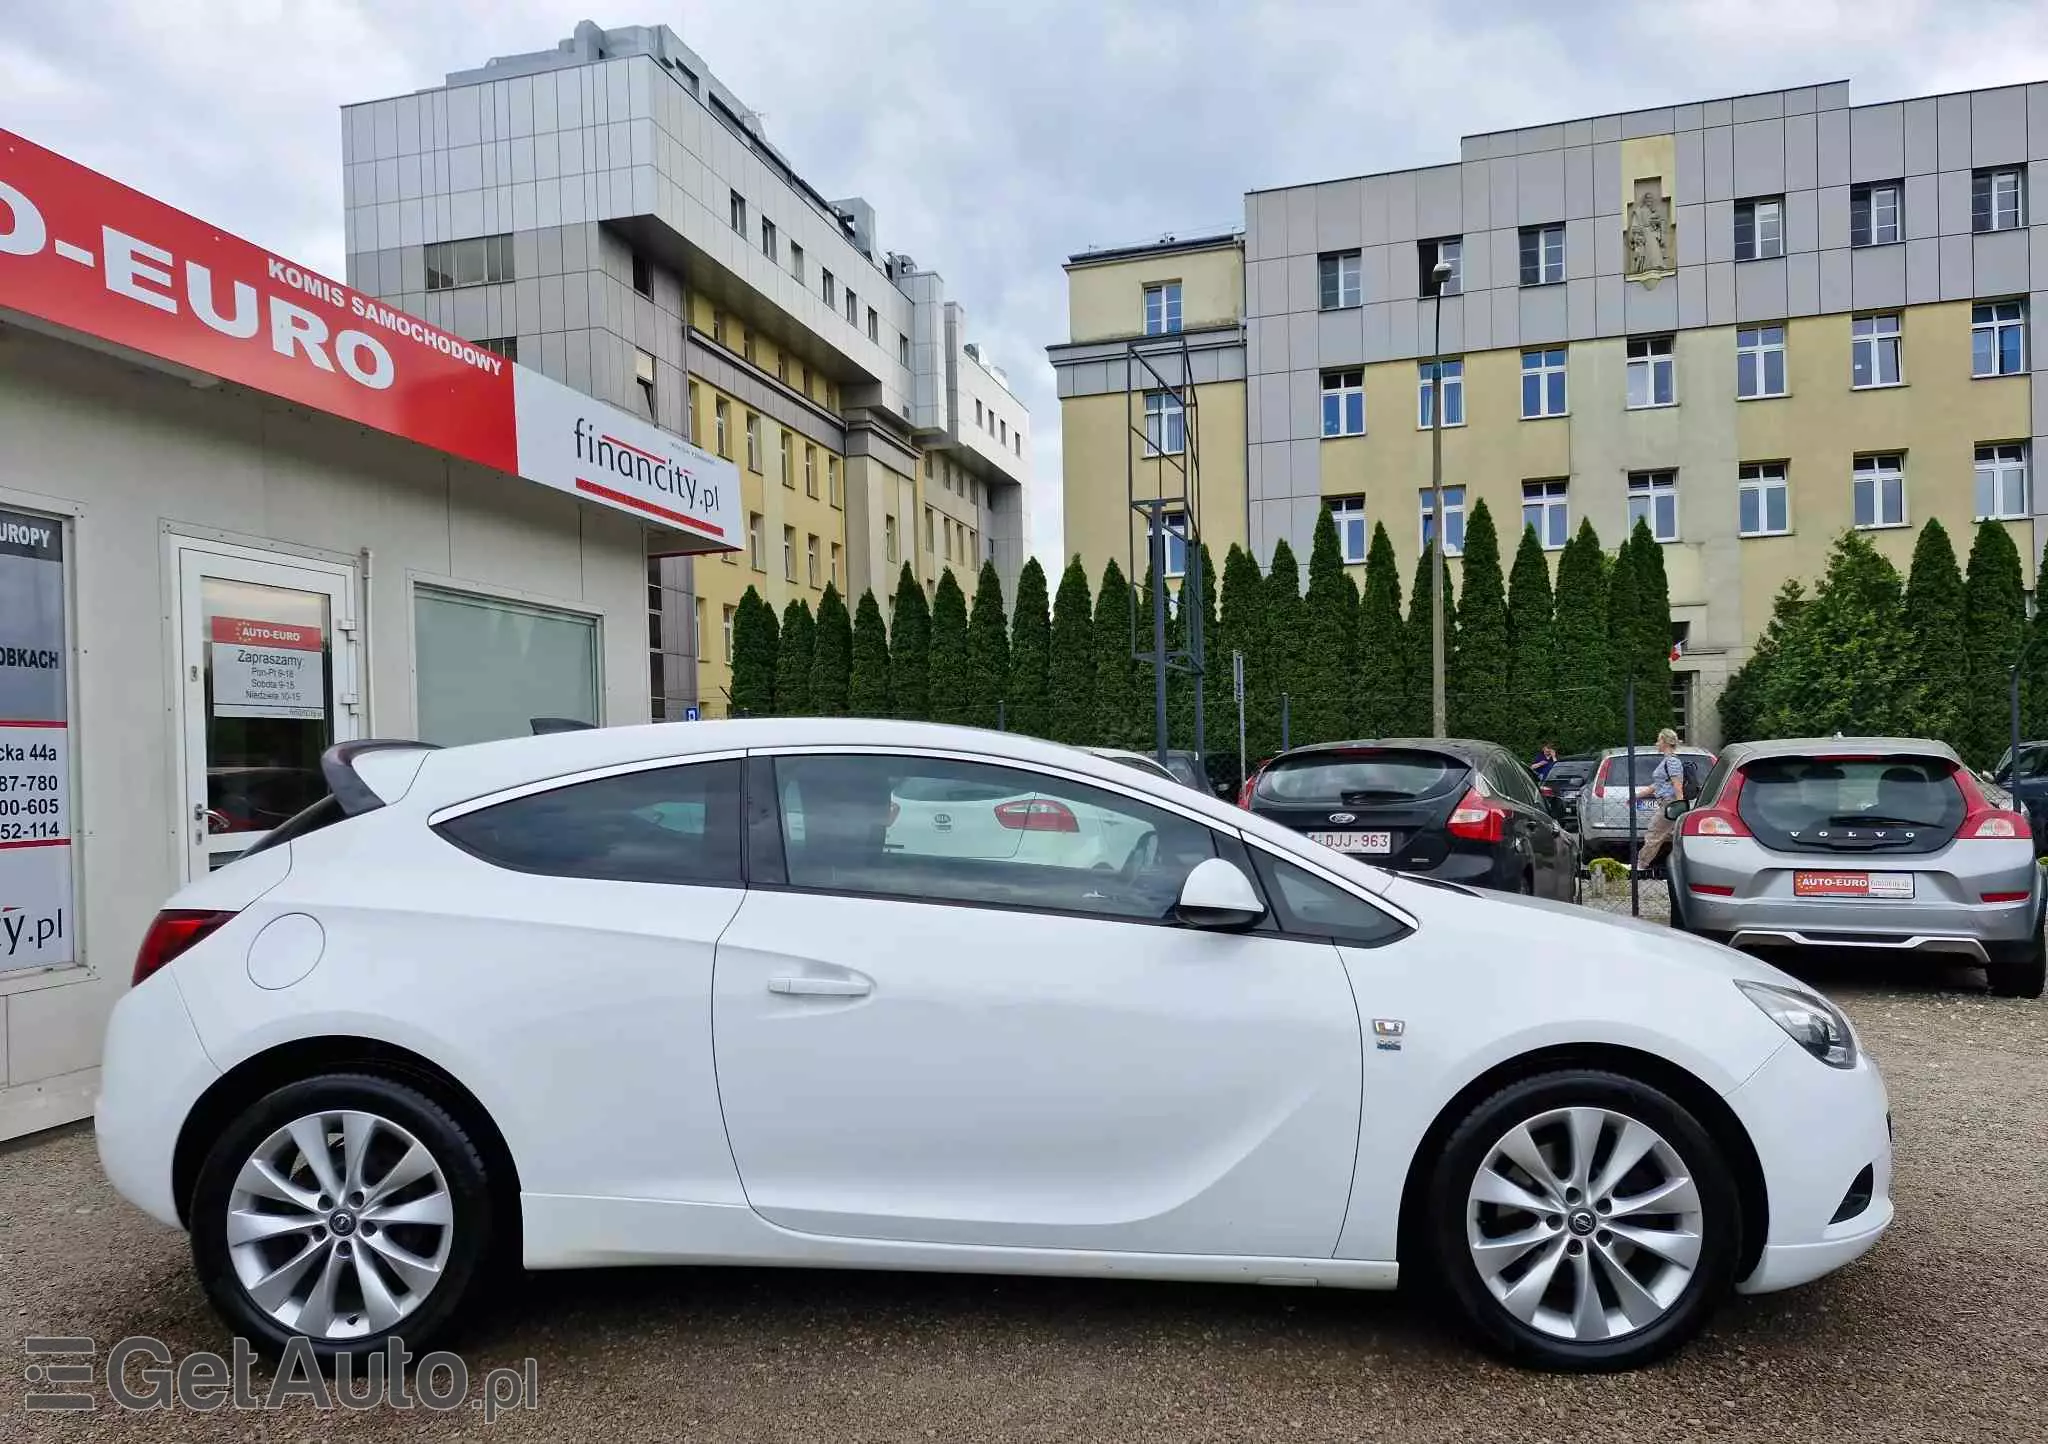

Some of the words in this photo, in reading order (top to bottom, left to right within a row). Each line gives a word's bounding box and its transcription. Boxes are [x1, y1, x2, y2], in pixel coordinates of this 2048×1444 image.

[267, 257, 345, 308] KOMIS
[351, 295, 502, 376] SAMOCHODOWY
[574, 417, 720, 513] financity.pl
[242, 627, 301, 642] AUTO-EURO
[237, 649, 303, 669] Zapraszamy
[29, 743, 57, 761] 44a
[0, 775, 58, 792] 87-780
[0, 798, 59, 816] 00-605
[0, 820, 60, 840] 52-114
[1802, 878, 1868, 888] AUTO-EURO
[0, 907, 62, 955] y.pl
